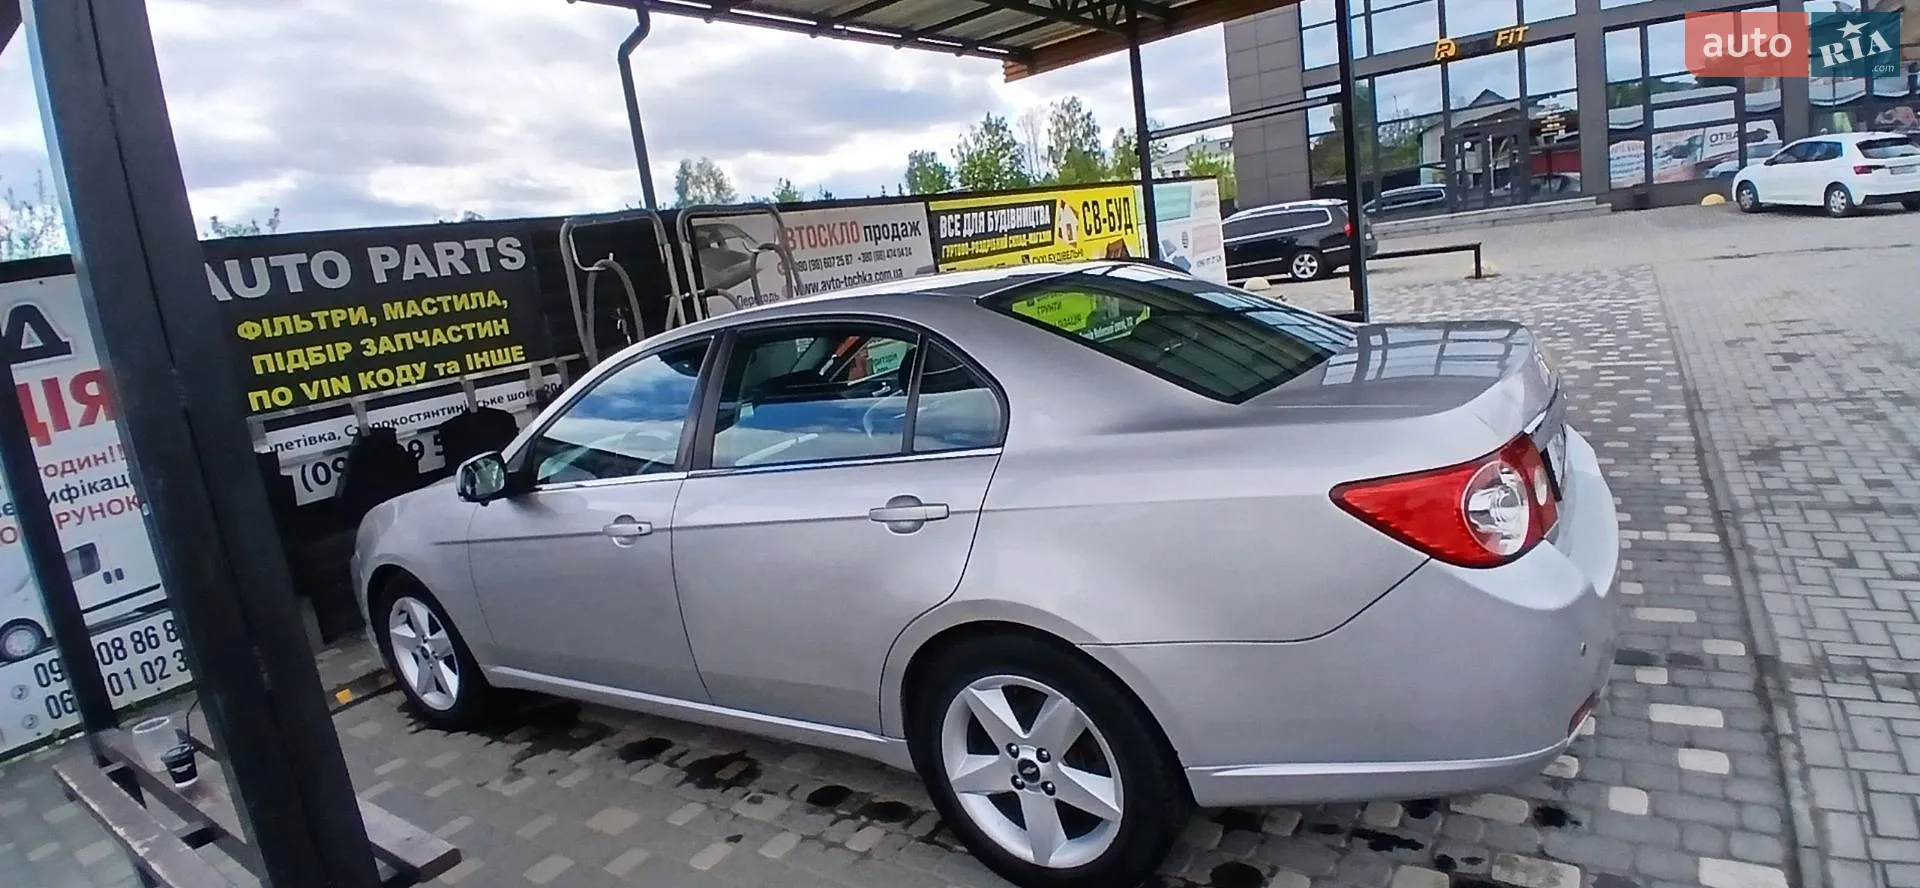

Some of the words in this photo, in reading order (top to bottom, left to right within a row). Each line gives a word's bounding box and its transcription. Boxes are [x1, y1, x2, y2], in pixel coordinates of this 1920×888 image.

[775, 220, 860, 251] ВТОСКЛО
[863, 219, 922, 246] продаж
[940, 212, 961, 239] ВСЕ
[963, 210, 986, 238] ДЛЯ
[987, 204, 1051, 233] БУДІВНИЦТВА
[1082, 196, 1134, 237] СВ-БУД
[366, 236, 527, 284] PARTS
[237, 304, 377, 341] ФІЛЬТРИ,
[382, 289, 509, 322] МАСТИЛА,
[252, 341, 352, 375] ПІДБІР
[360, 318, 510, 358] ЗАПЧАСТИН
[248, 386, 293, 411] ПО
[300, 375, 352, 400] VIN
[358, 361, 427, 391] КОДУ
[434, 364, 461, 376] та
[466, 345, 527, 371] ІНШЕ
[39, 444, 126, 479] один!!
[269, 433, 341, 453] петівка,
[97, 637, 128, 666] 08
[129, 624, 161, 654] 86
[106, 667, 137, 697] 01
[140, 655, 171, 685] 02
